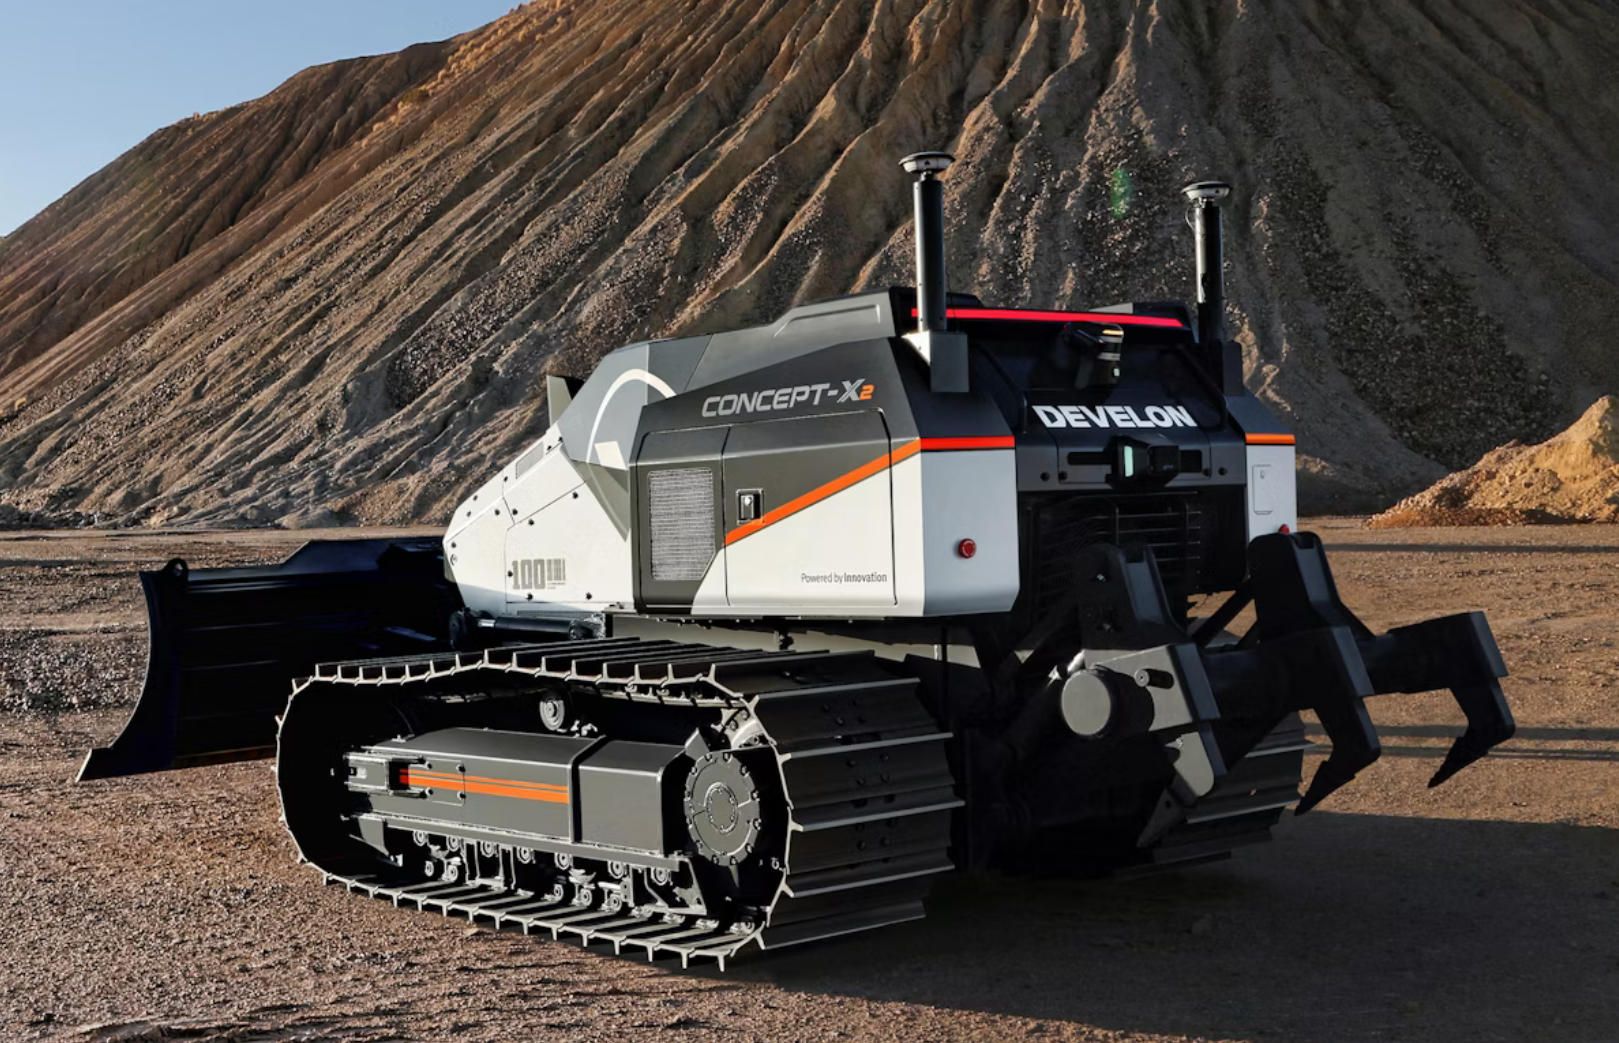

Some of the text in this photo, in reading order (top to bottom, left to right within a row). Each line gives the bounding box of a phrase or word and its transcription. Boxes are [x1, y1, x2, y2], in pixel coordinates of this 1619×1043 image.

[702, 378, 875, 417] CONCEPT-X2
[1032, 405, 1198, 428] DEVELON
[512, 559, 546, 590] 100
[801, 571, 888, 584] Powered by Innovation
